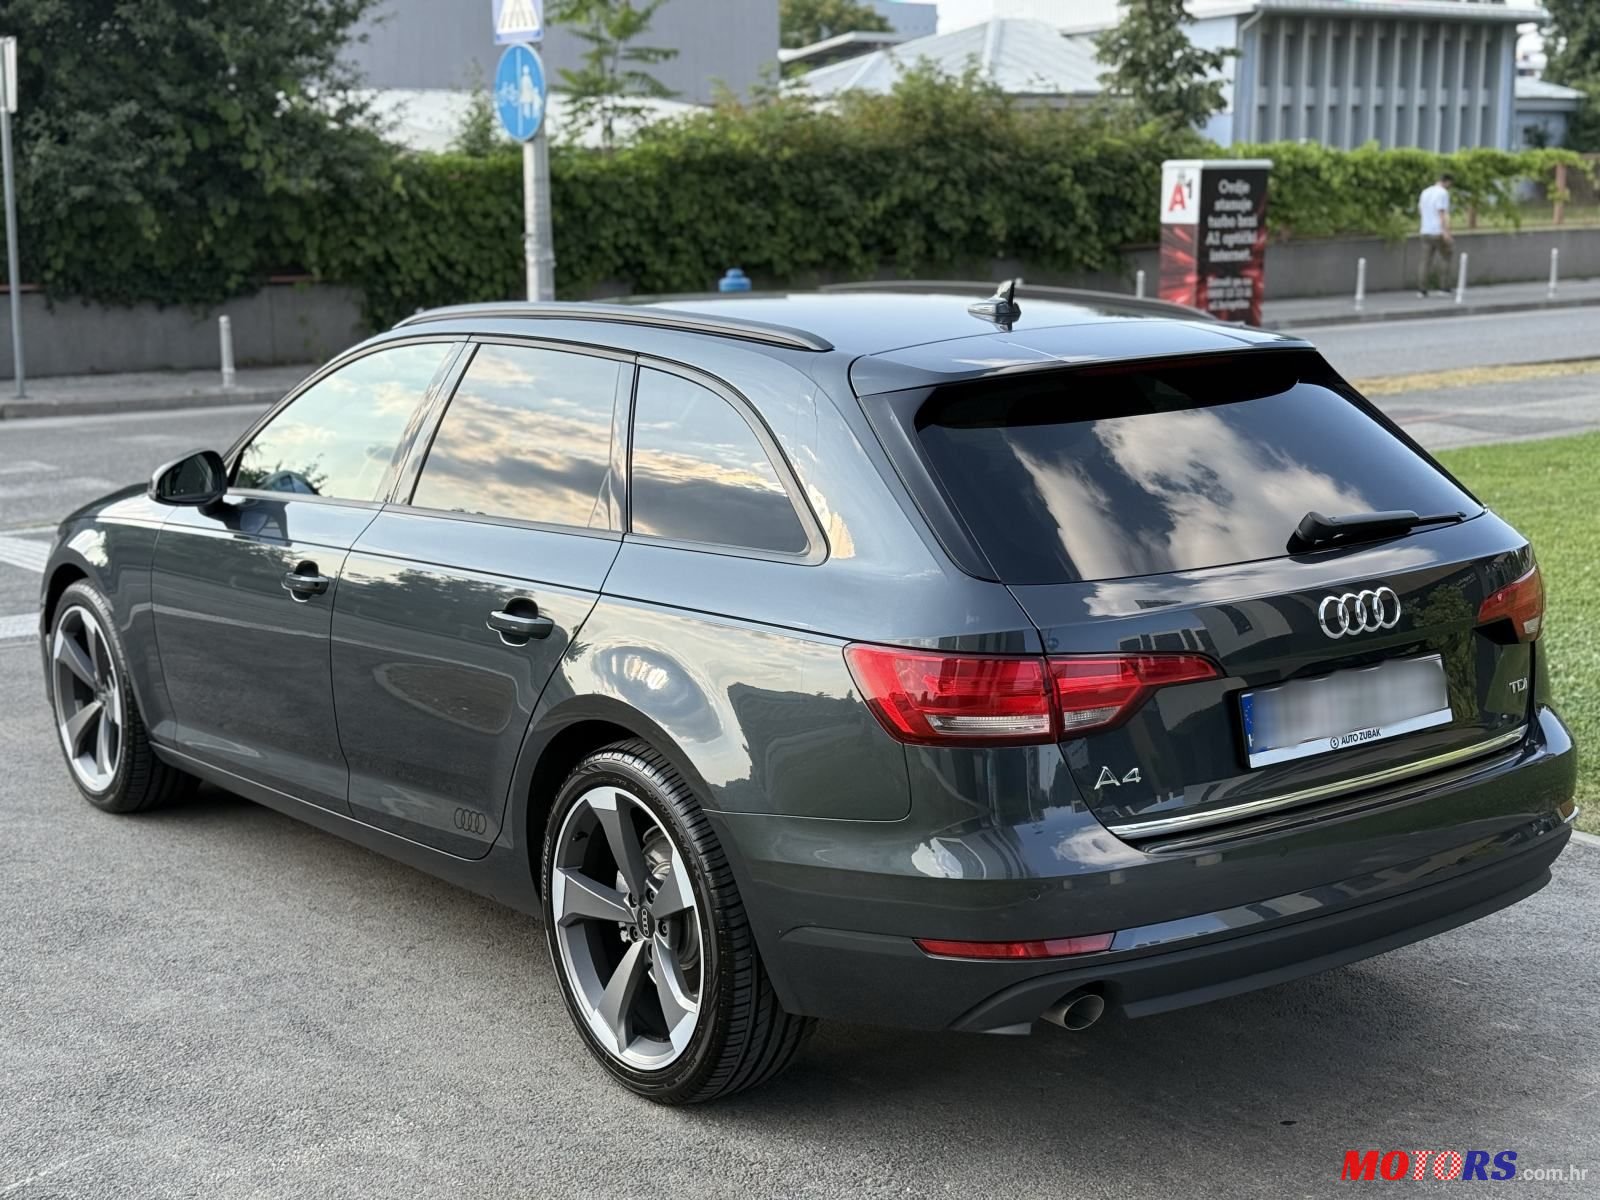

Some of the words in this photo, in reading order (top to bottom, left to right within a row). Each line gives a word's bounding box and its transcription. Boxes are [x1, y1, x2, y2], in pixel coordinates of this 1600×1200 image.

[1168, 178, 1193, 212] A1
[1341, 733, 1359, 745] AUTO
[1358, 727, 1382, 741] ZUBAK
[1094, 765, 1142, 790] A4
